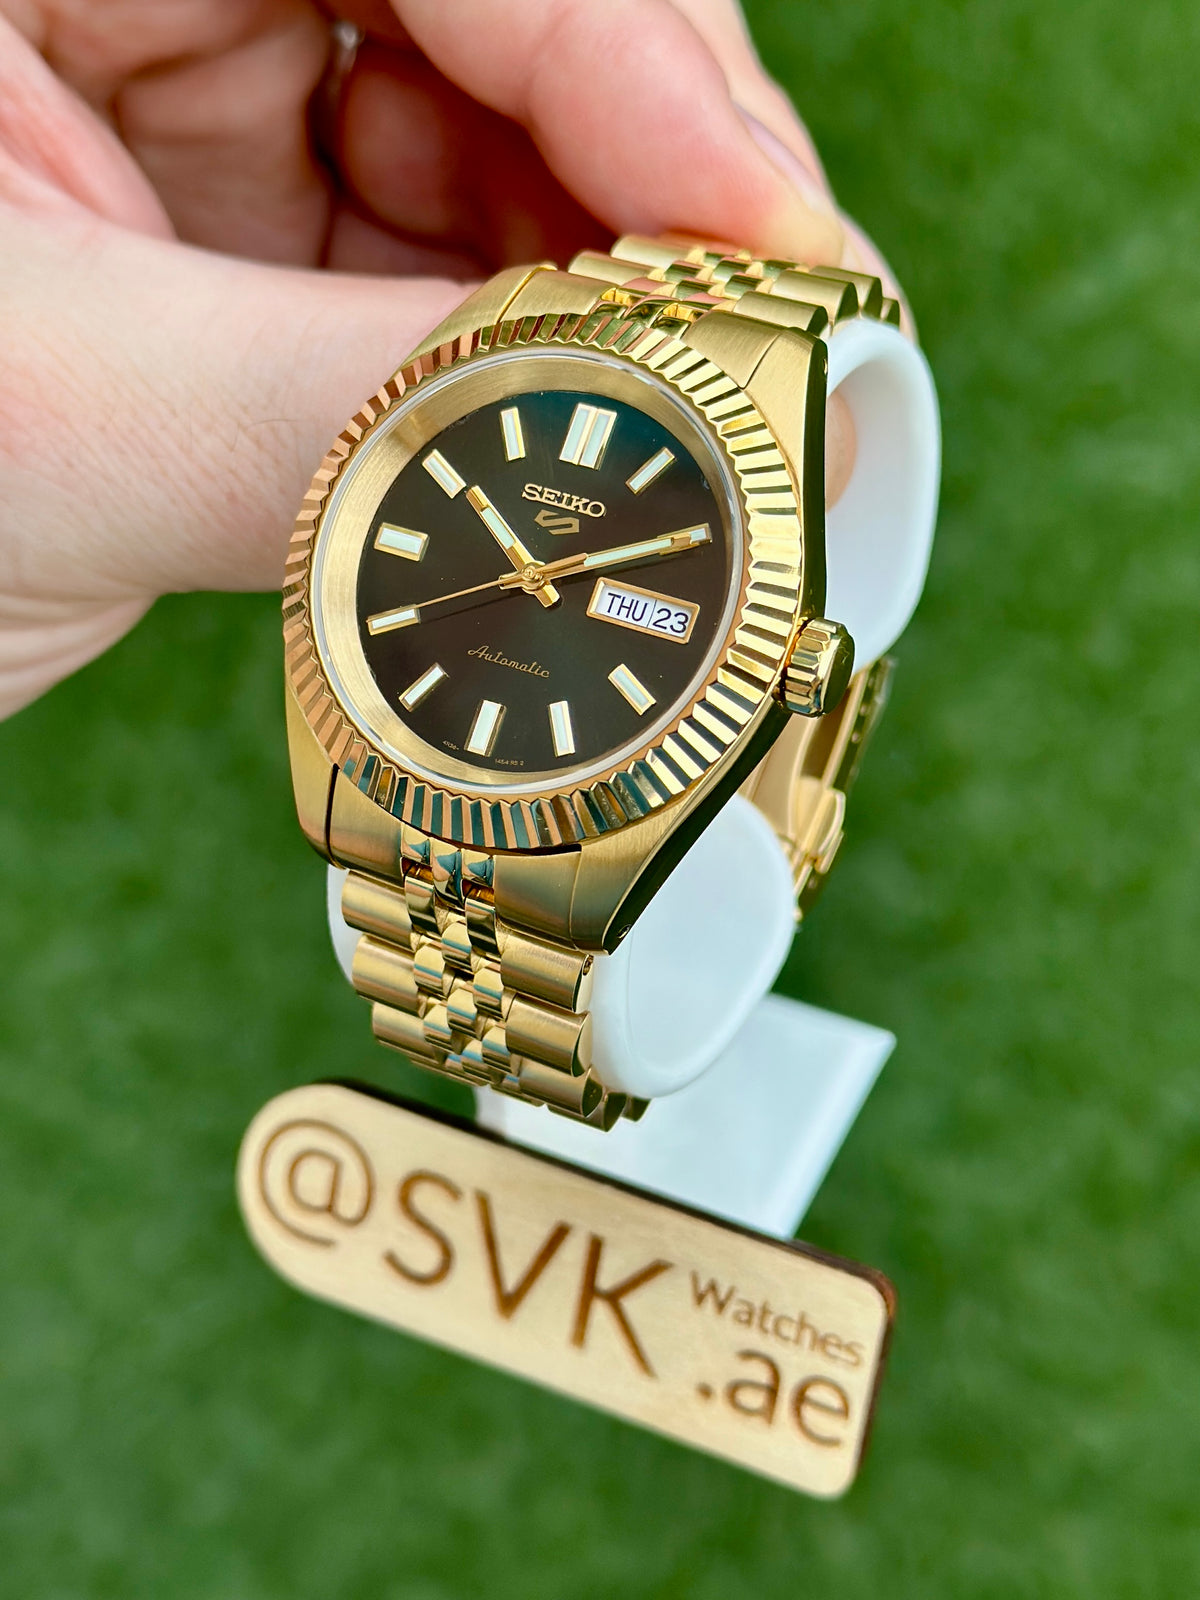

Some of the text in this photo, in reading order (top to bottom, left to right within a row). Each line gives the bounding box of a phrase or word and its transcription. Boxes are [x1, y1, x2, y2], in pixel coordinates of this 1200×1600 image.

[522, 483, 606, 518] SEIKO
[606, 592, 689, 634] THU 23
[467, 645, 550, 678] Automatic
[258, 1119, 673, 1378] @SVK
[690, 1272, 863, 1367] Watches
[697, 1350, 851, 1447] .ae
